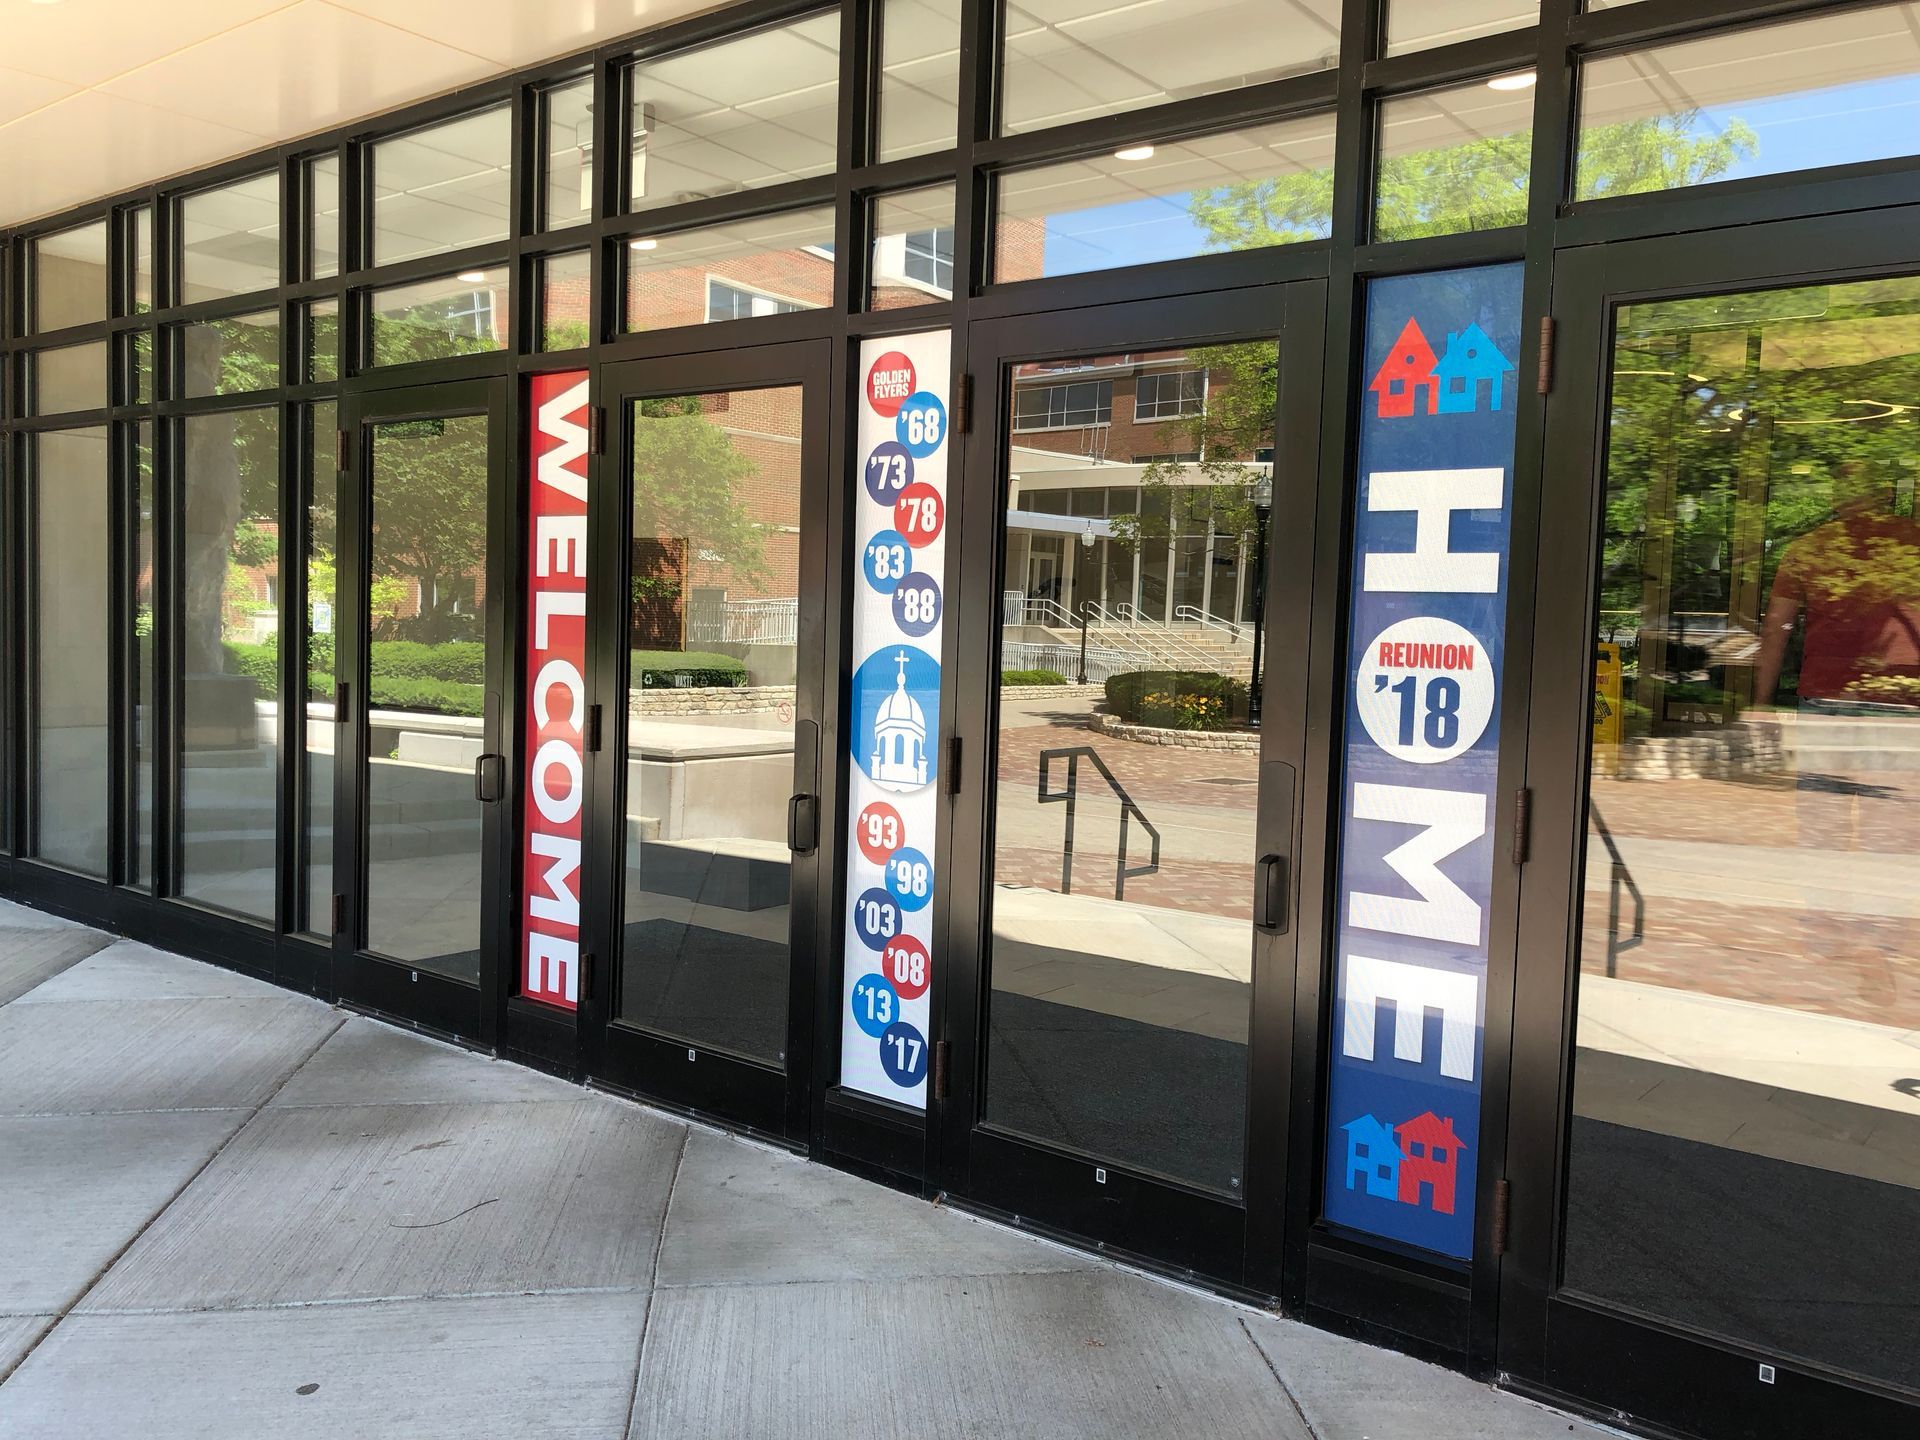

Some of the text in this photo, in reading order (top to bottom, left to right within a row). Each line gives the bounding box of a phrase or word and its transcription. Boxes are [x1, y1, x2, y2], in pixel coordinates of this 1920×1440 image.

[873, 369, 910, 385] GOLDEN
[874, 383, 909, 399] FLYERS
[901, 408, 940, 445] '68
[870, 455, 907, 490] '73
[900, 497, 937, 533] '78
[868, 545, 905, 579] '83
[897, 588, 935, 623] '88
[1379, 642, 1474, 670] REUNION
[528, 379, 589, 1003] WELCOME
[675, 675, 694, 688] WASTE
[1374, 674, 1461, 749] '18
[861, 813, 898, 849] '93
[890, 859, 928, 897] '98
[859, 900, 895, 938] '03
[887, 947, 925, 987] '08
[857, 984, 891, 1024] '13
[887, 1034, 922, 1073] '17
